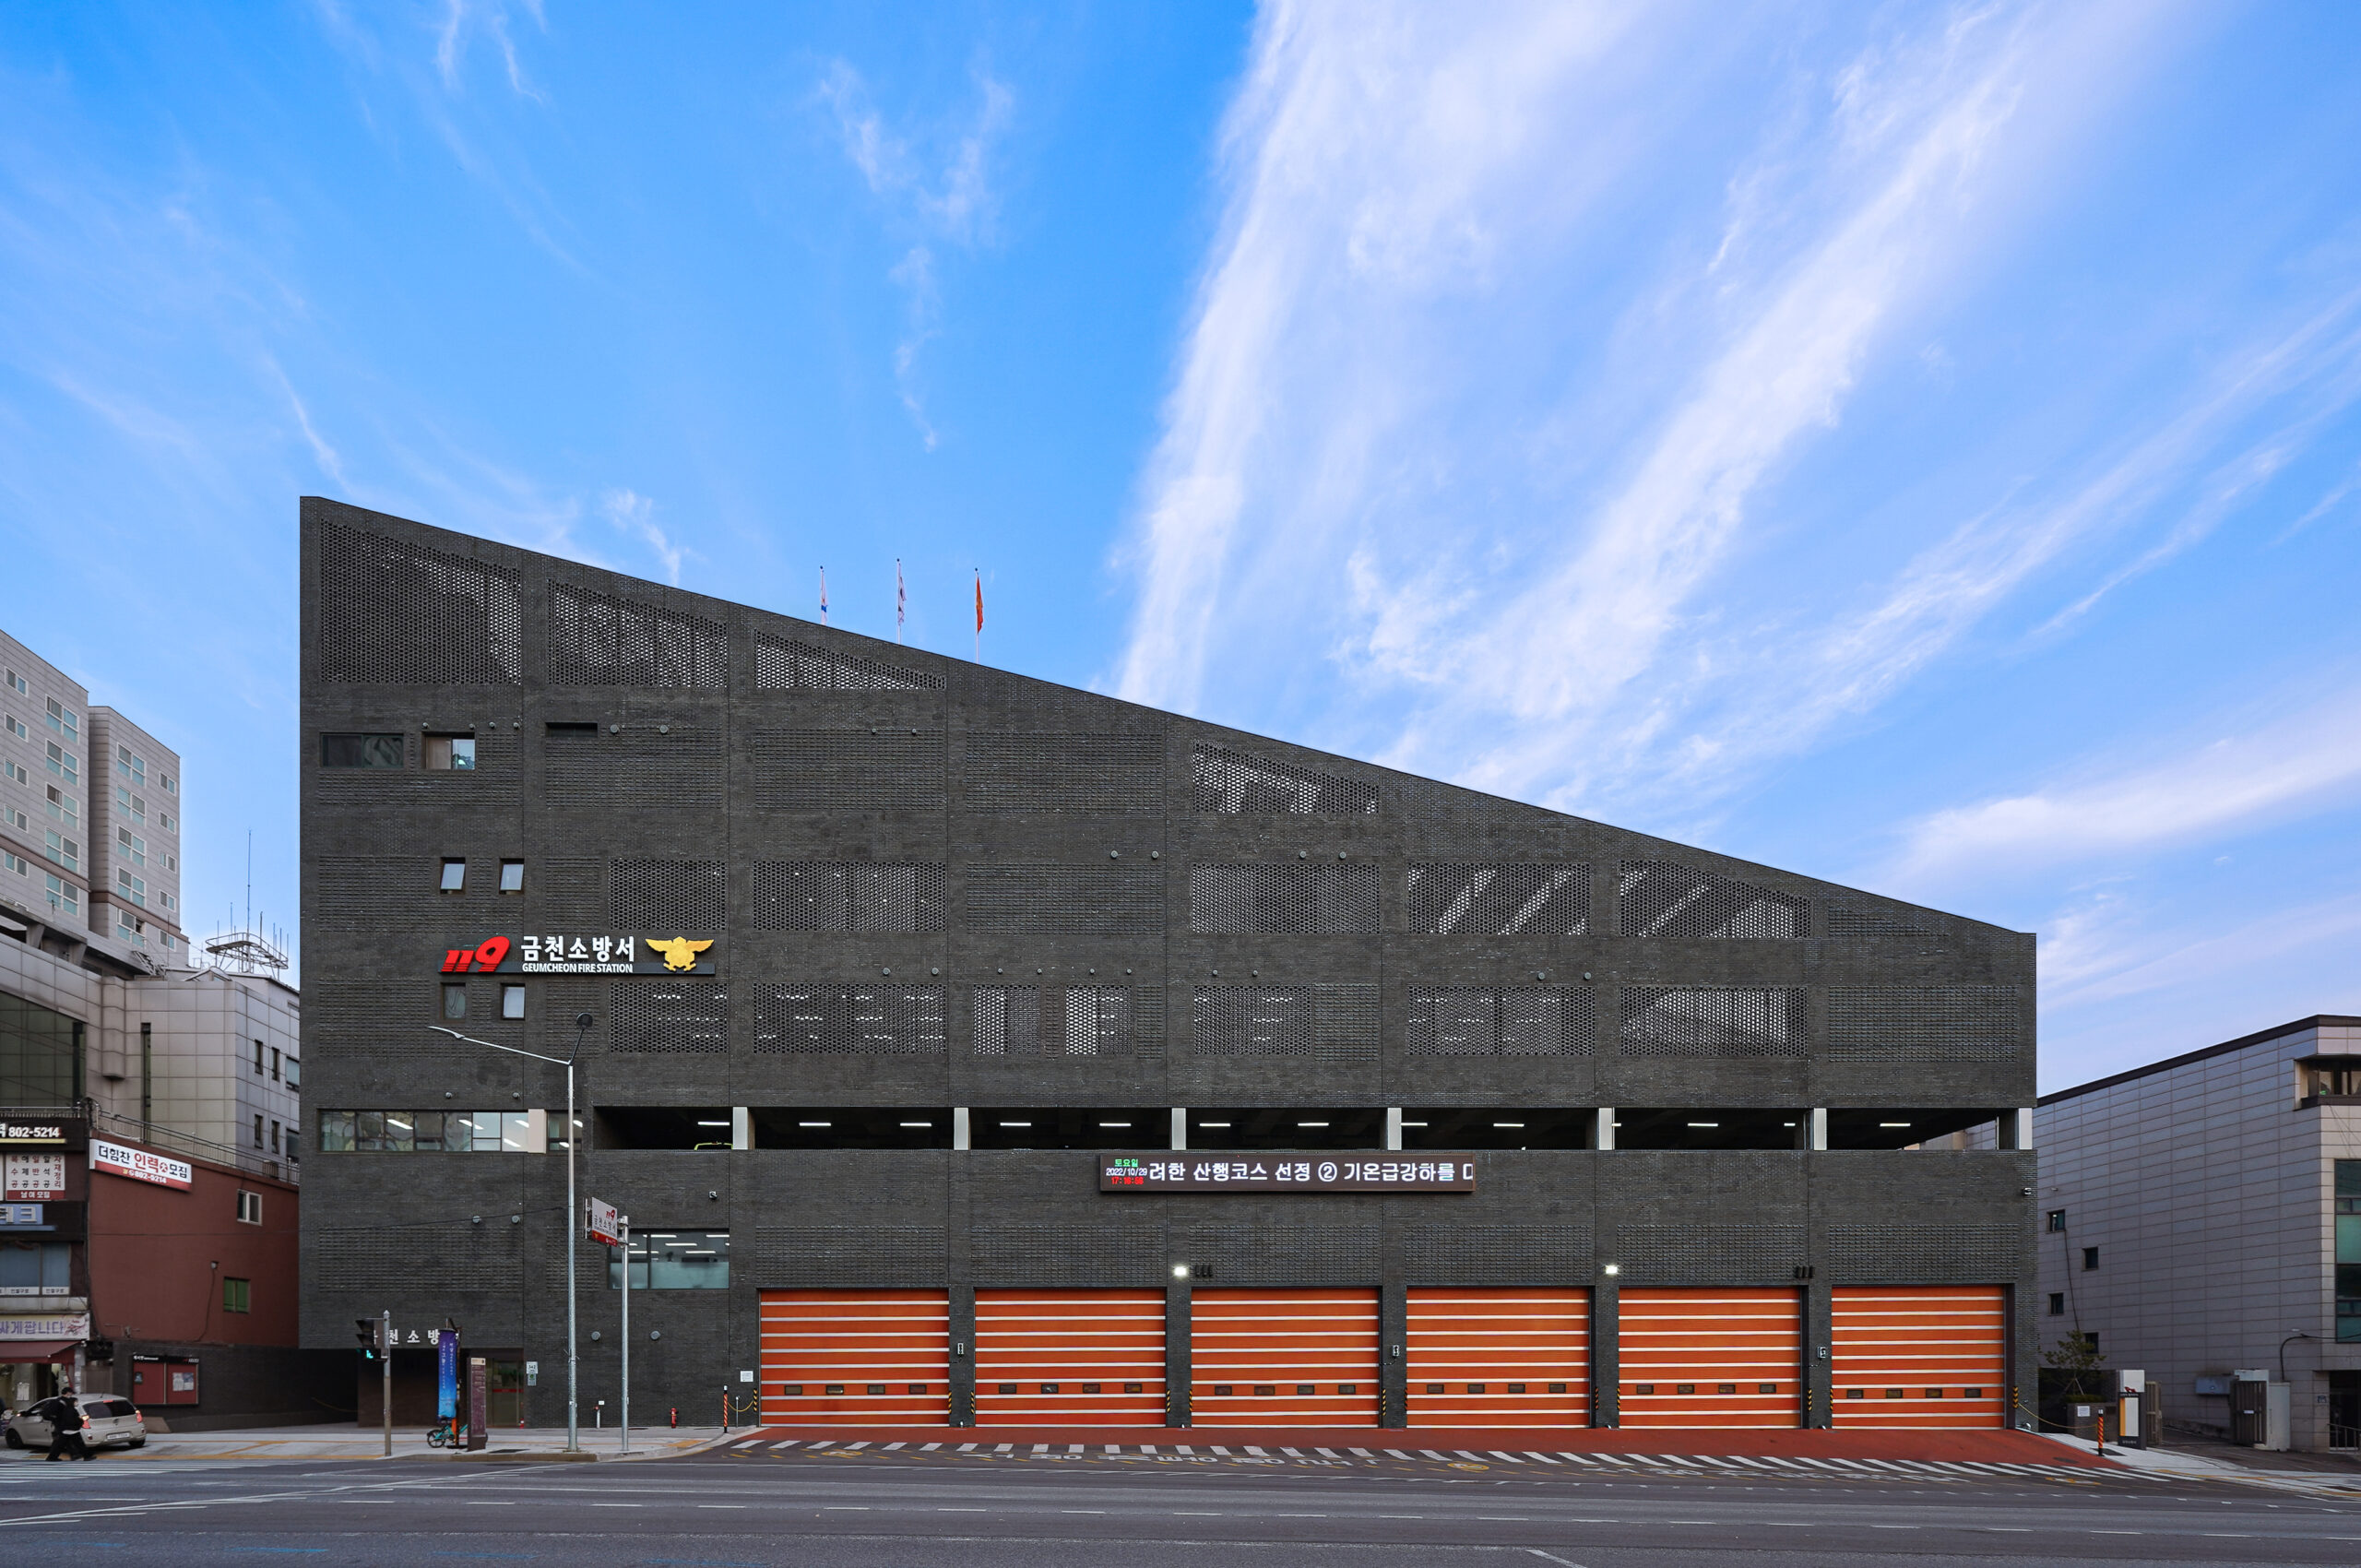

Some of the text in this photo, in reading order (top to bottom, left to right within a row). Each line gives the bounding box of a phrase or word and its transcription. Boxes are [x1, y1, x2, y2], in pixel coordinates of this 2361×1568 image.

[440, 935, 511, 972] 119
[520, 935, 635, 962] 금천소방서
[522, 963, 634, 973] GEUMCHEON FIRE STATION
[8, 1126, 61, 1138] 802-5214
[98, 1145, 130, 1164] 더힘찬
[134, 1153, 159, 1173] 인력
[169, 1163, 187, 1179] 모집
[1114, 1158, 1138, 1167] 토요일
[1106, 1167, 1147, 1176] 2022/10/29
[1149, 1162, 1186, 1182] 려한
[1192, 1162, 1268, 1182] 산행코스
[1275, 1162, 1311, 1182] 선정
[1344, 1162, 1455, 1182] 기온급강하를
